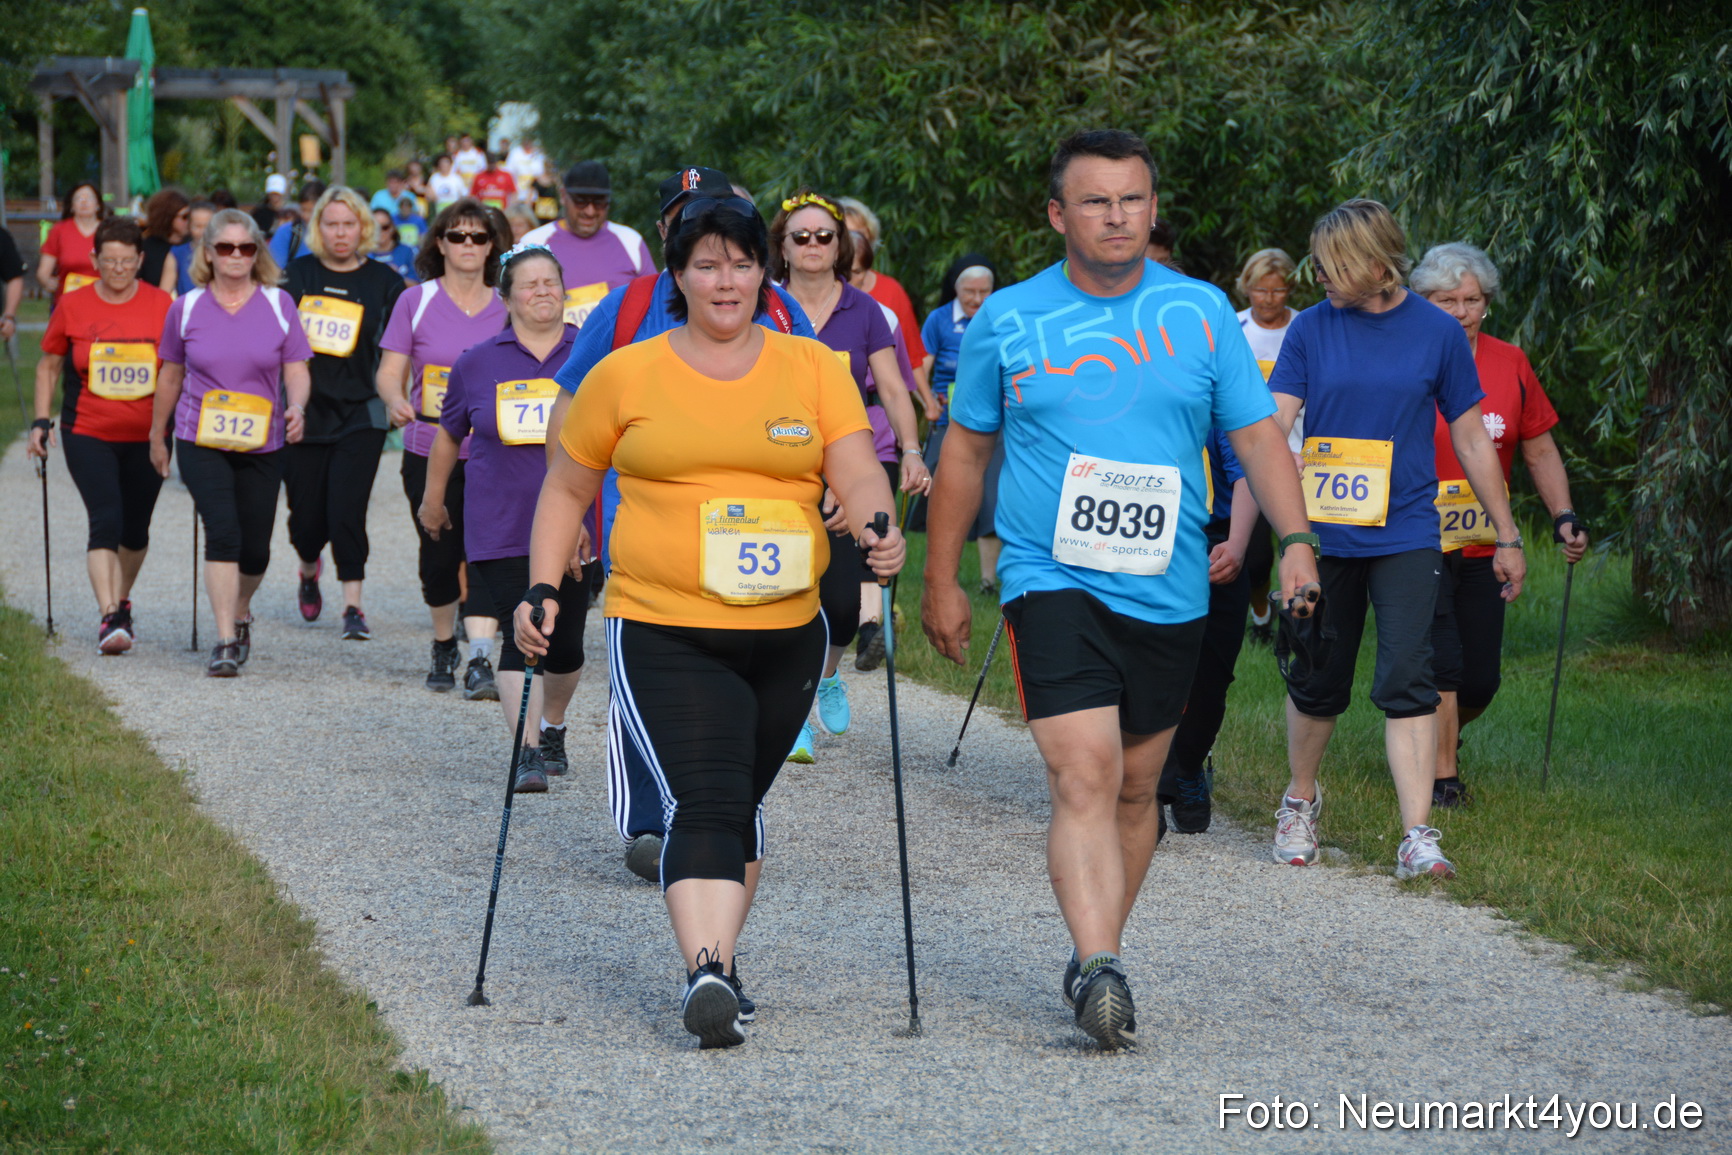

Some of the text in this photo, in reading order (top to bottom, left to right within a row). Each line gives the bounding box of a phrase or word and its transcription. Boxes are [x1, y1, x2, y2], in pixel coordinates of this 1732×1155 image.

[302, 317, 351, 341] 1198
[97, 365, 150, 385] 1099
[514, 403, 556, 424] 71
[213, 414, 254, 437] 312
[1071, 461, 1166, 488] df-sports
[1141, 487, 1177, 495] Zeitmessung
[1314, 472, 1369, 501] 766
[719, 516, 760, 525] firmenlauf
[1071, 495, 1166, 541] 8939
[1059, 536, 1169, 558] www.df-sports.de
[737, 542, 781, 576] 53
[738, 582, 756, 591] Gaby
